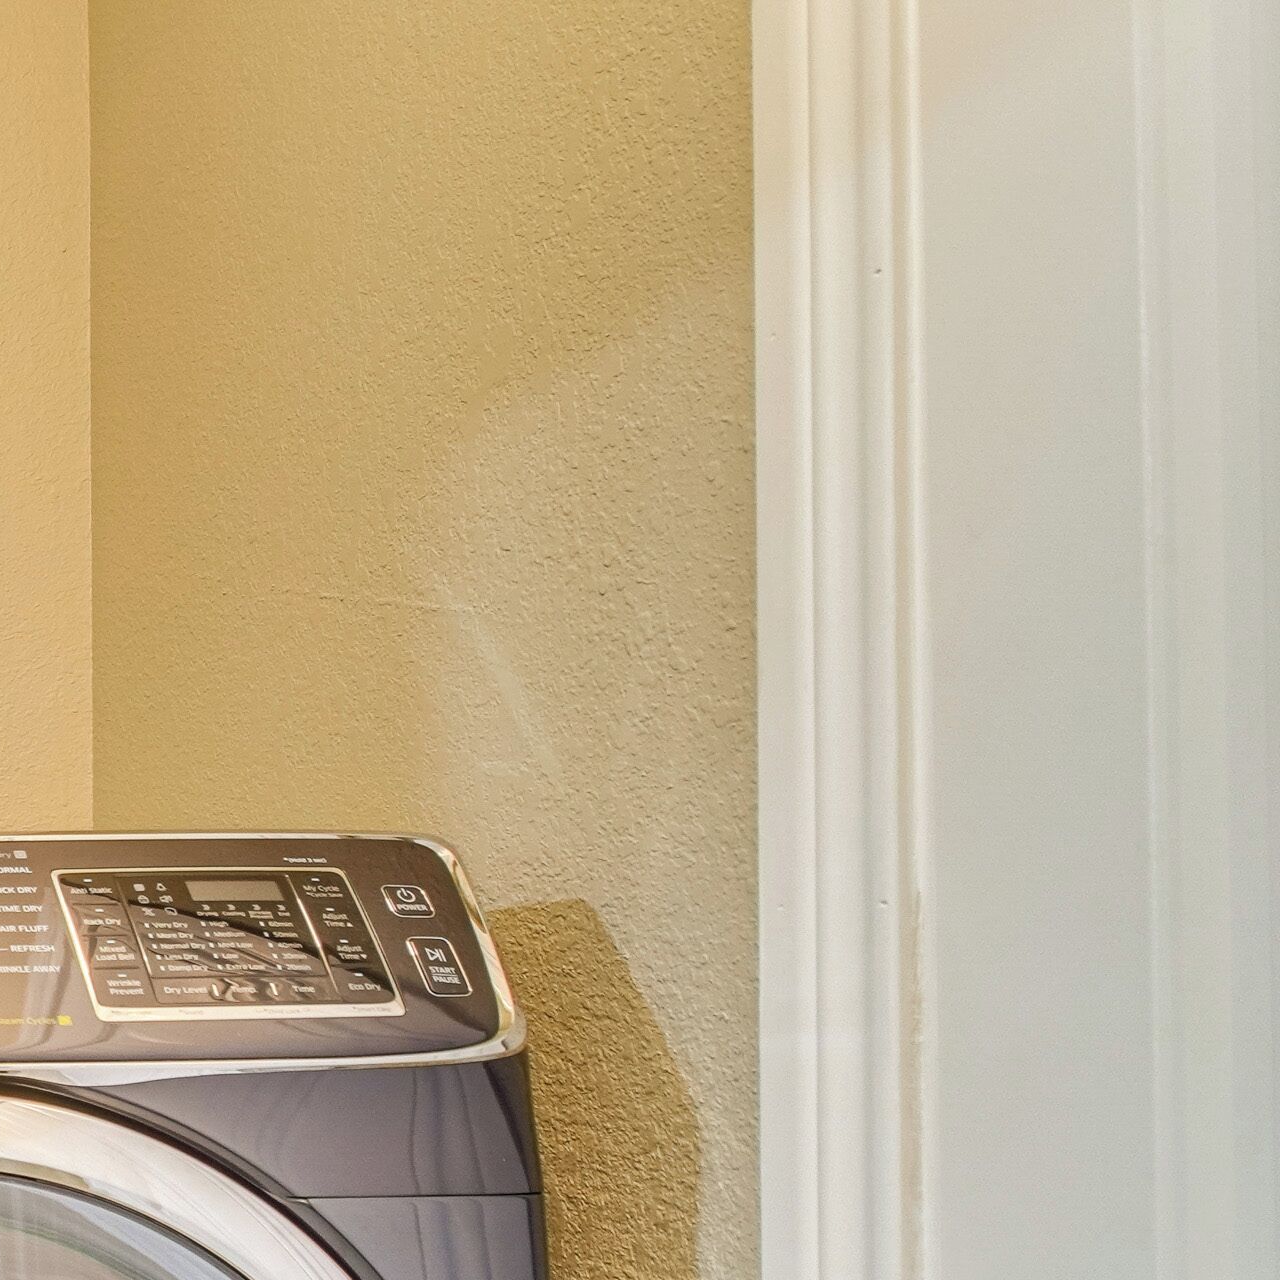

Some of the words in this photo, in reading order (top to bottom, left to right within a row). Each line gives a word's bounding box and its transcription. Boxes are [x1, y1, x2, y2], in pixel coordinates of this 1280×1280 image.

[17, 886, 37, 894] DRY
[396, 903, 428, 911] POWER
[322, 913, 348, 921] Adjust
[0, 925, 17, 933] AIR
[18, 925, 49, 933] FLUFF
[10, 945, 55, 953] REFRESH
[336, 945, 363, 953] Adjust
[429, 966, 456, 974] START
[432, 976, 461, 984] PAUSE
[164, 986, 182, 994] Dry
[183, 986, 208, 994] Level
[364, 983, 382, 992] Dry
